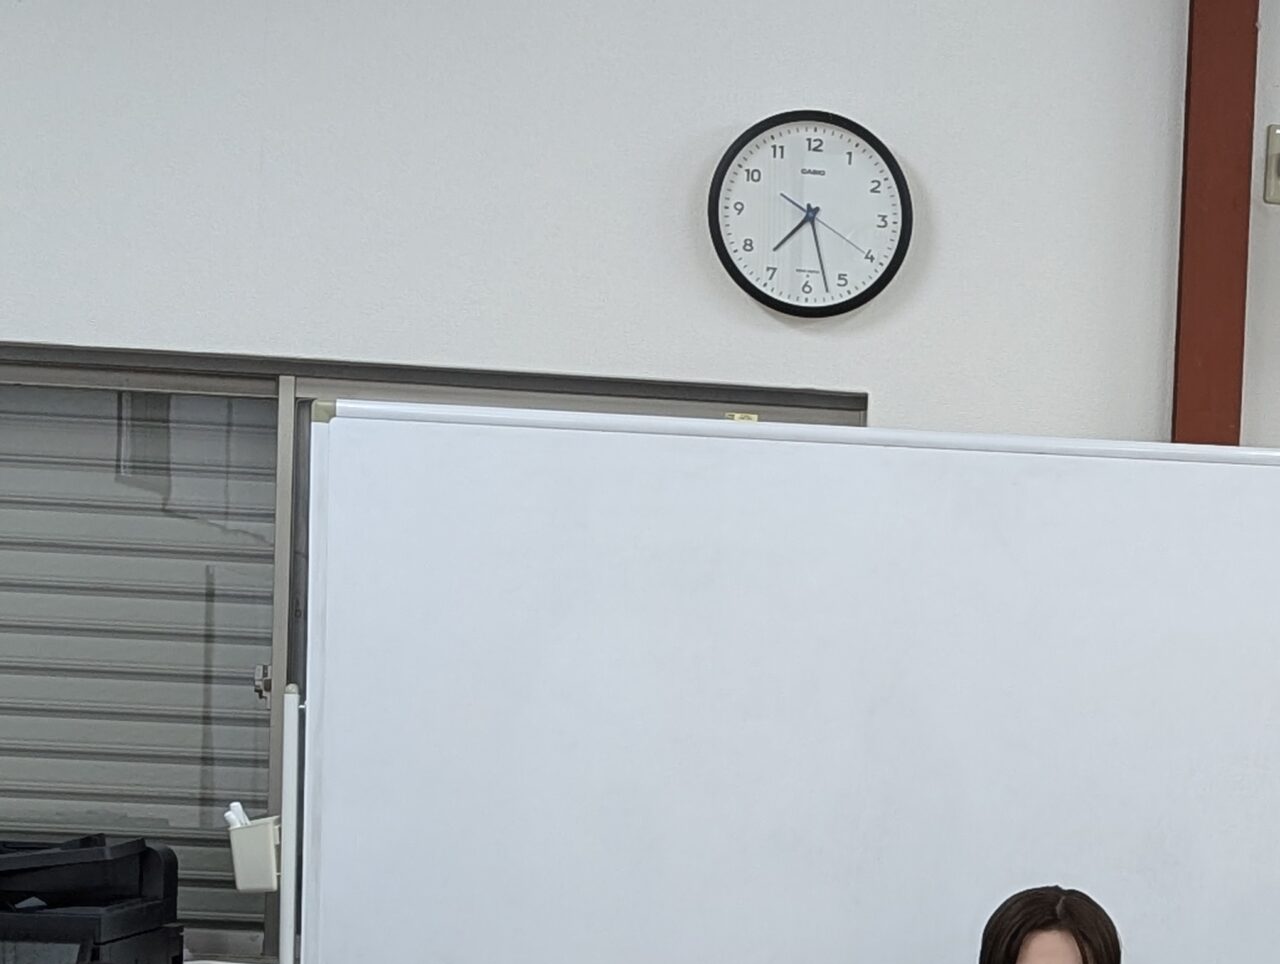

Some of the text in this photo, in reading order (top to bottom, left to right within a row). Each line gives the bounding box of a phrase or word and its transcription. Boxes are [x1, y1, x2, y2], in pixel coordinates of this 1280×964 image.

[771, 145, 785, 159] 11
[806, 138, 824, 152] 12
[846, 151, 852, 165] 1
[744, 168, 761, 183] 10
[870, 180, 881, 194] 2
[733, 201, 745, 215] 9
[876, 214, 888, 228] 3
[742, 238, 754, 252] 8
[864, 249, 875, 263] 4
[766, 266, 777, 281] 7
[836, 273, 848, 287] 5
[801, 280, 813, 294] 6
